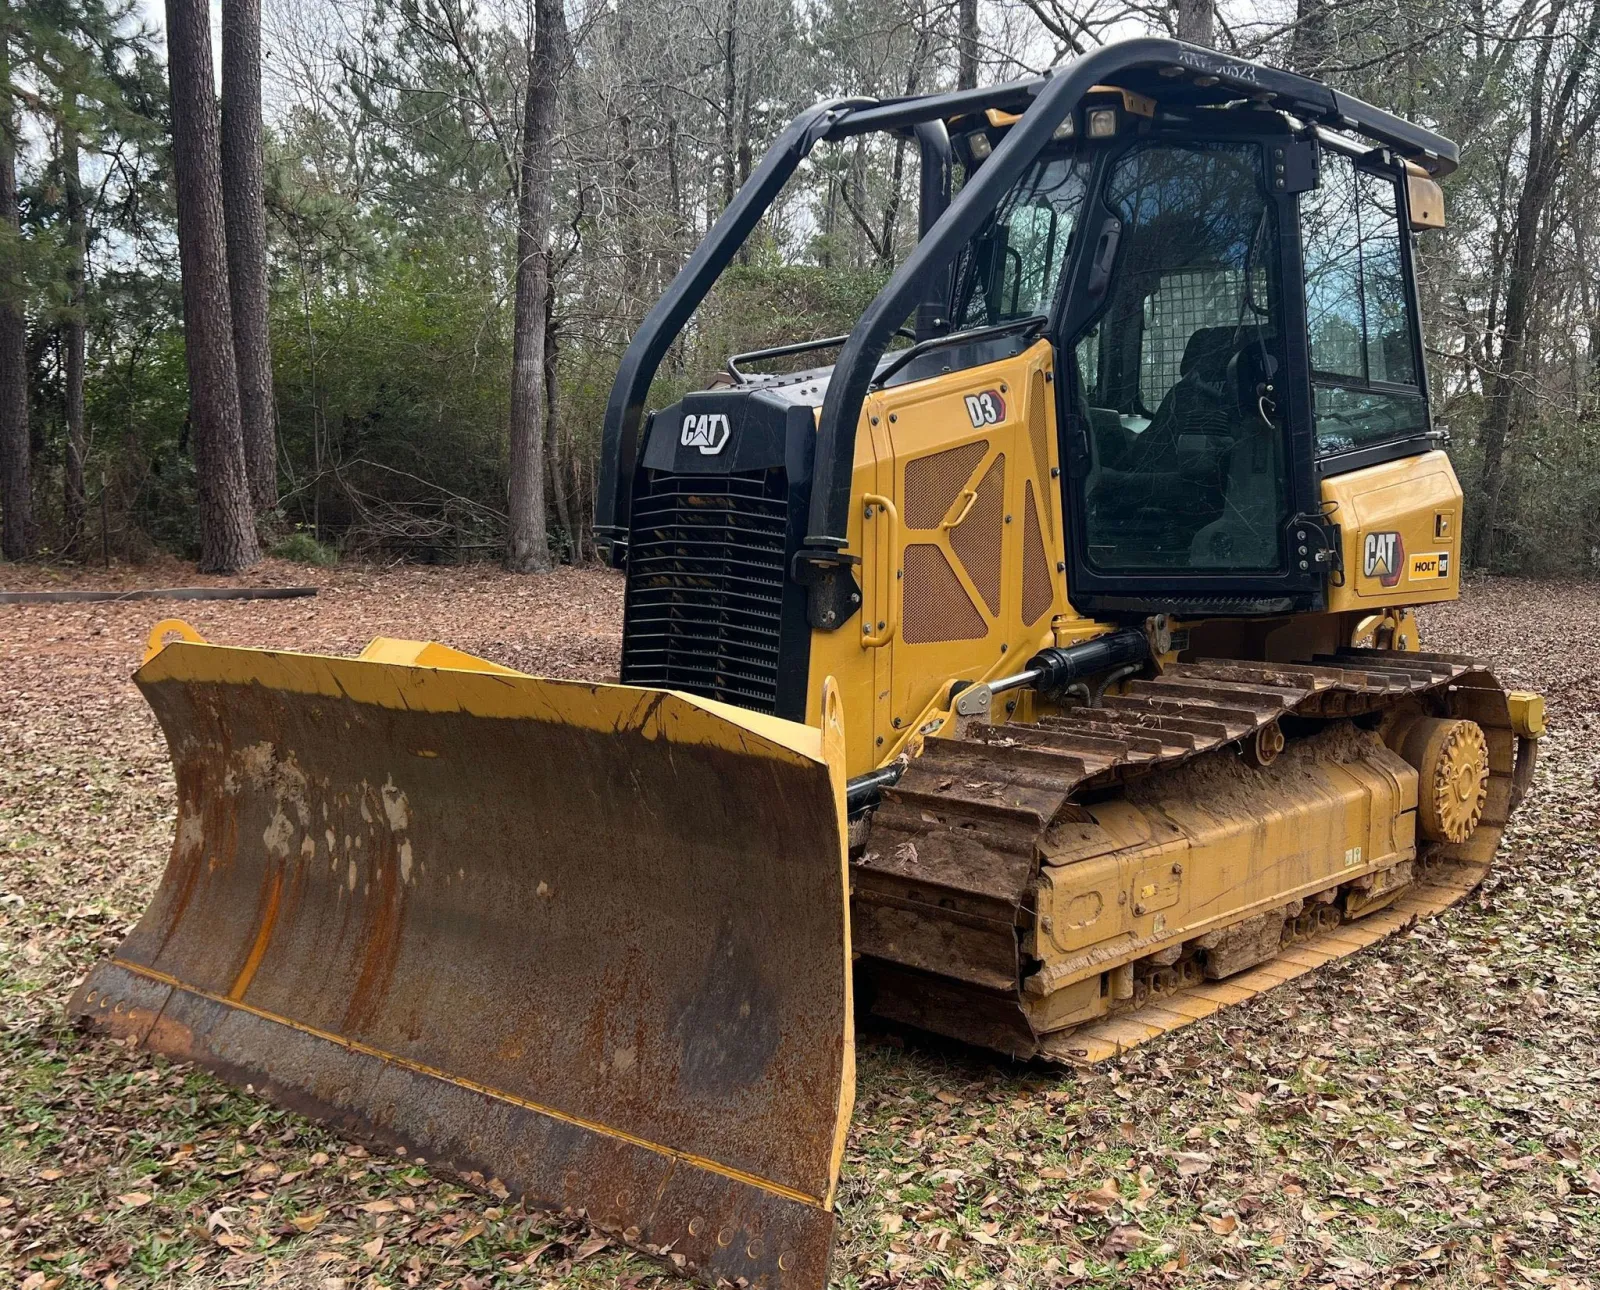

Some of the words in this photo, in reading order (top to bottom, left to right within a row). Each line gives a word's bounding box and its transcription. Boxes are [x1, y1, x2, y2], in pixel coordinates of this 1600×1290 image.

[965, 393, 997, 427] D3
[681, 414, 722, 447] CAT
[1364, 533, 1396, 577] CAT
[1414, 561, 1437, 572] HOLT
